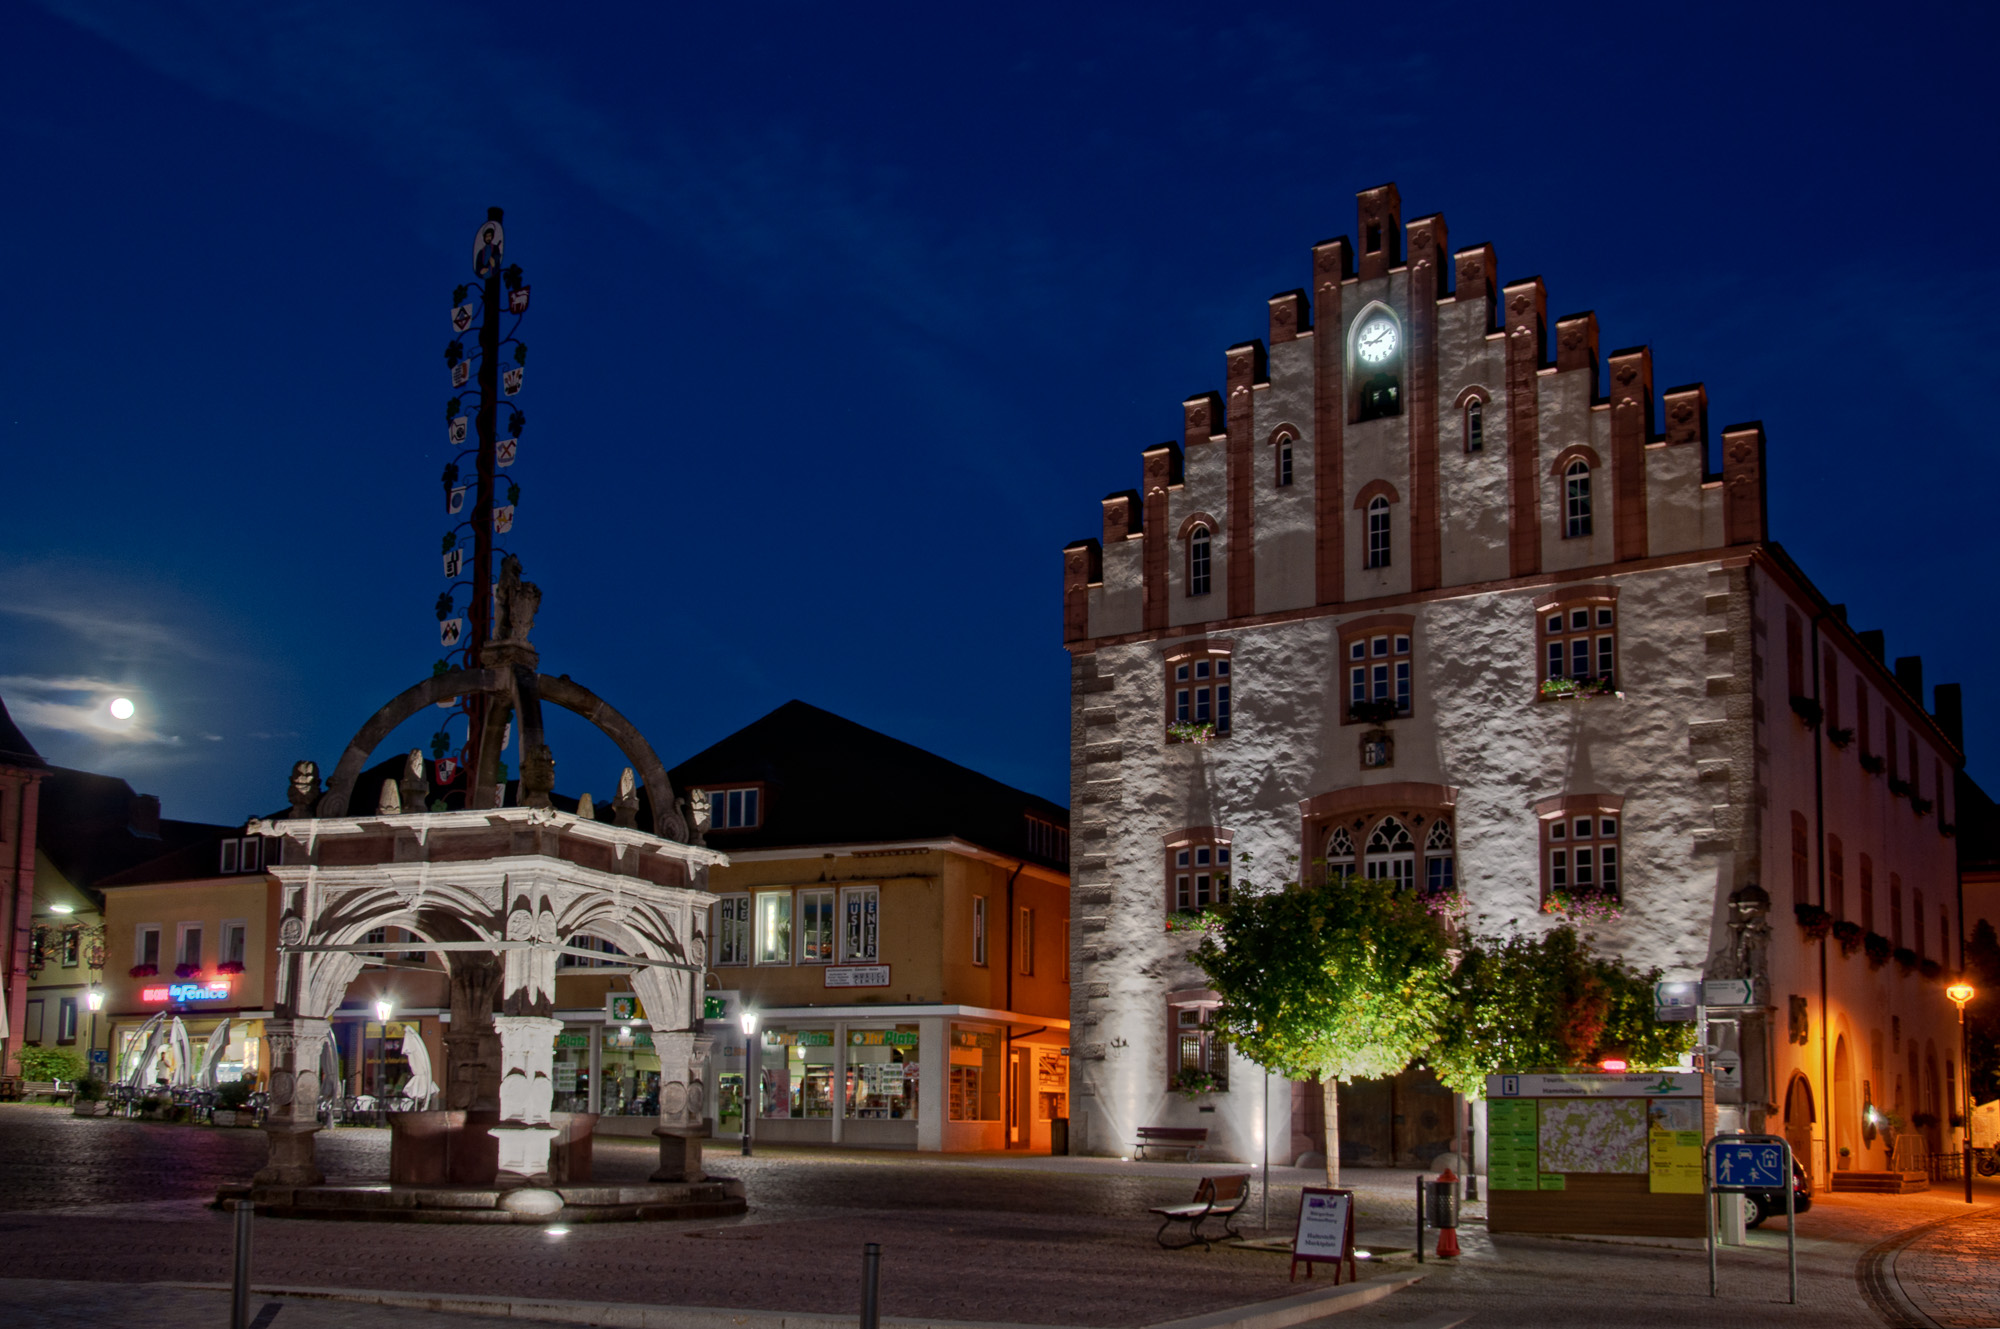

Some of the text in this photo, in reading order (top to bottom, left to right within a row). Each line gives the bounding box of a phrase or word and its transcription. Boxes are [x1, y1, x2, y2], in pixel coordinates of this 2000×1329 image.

[722, 900, 733, 951] MUSIC
[849, 893, 860, 947] MUSIC
[866, 891, 876, 956] CENTER
[177, 984, 228, 1002] Fenice
[796, 1029, 830, 1046] Platz
[884, 1030, 918, 1046] Platz
[1624, 1075, 1654, 1083] Saaletal
[1542, 1087, 1587, 1095] Hammelburg
[1305, 1240, 1336, 1248] Marktplatz
